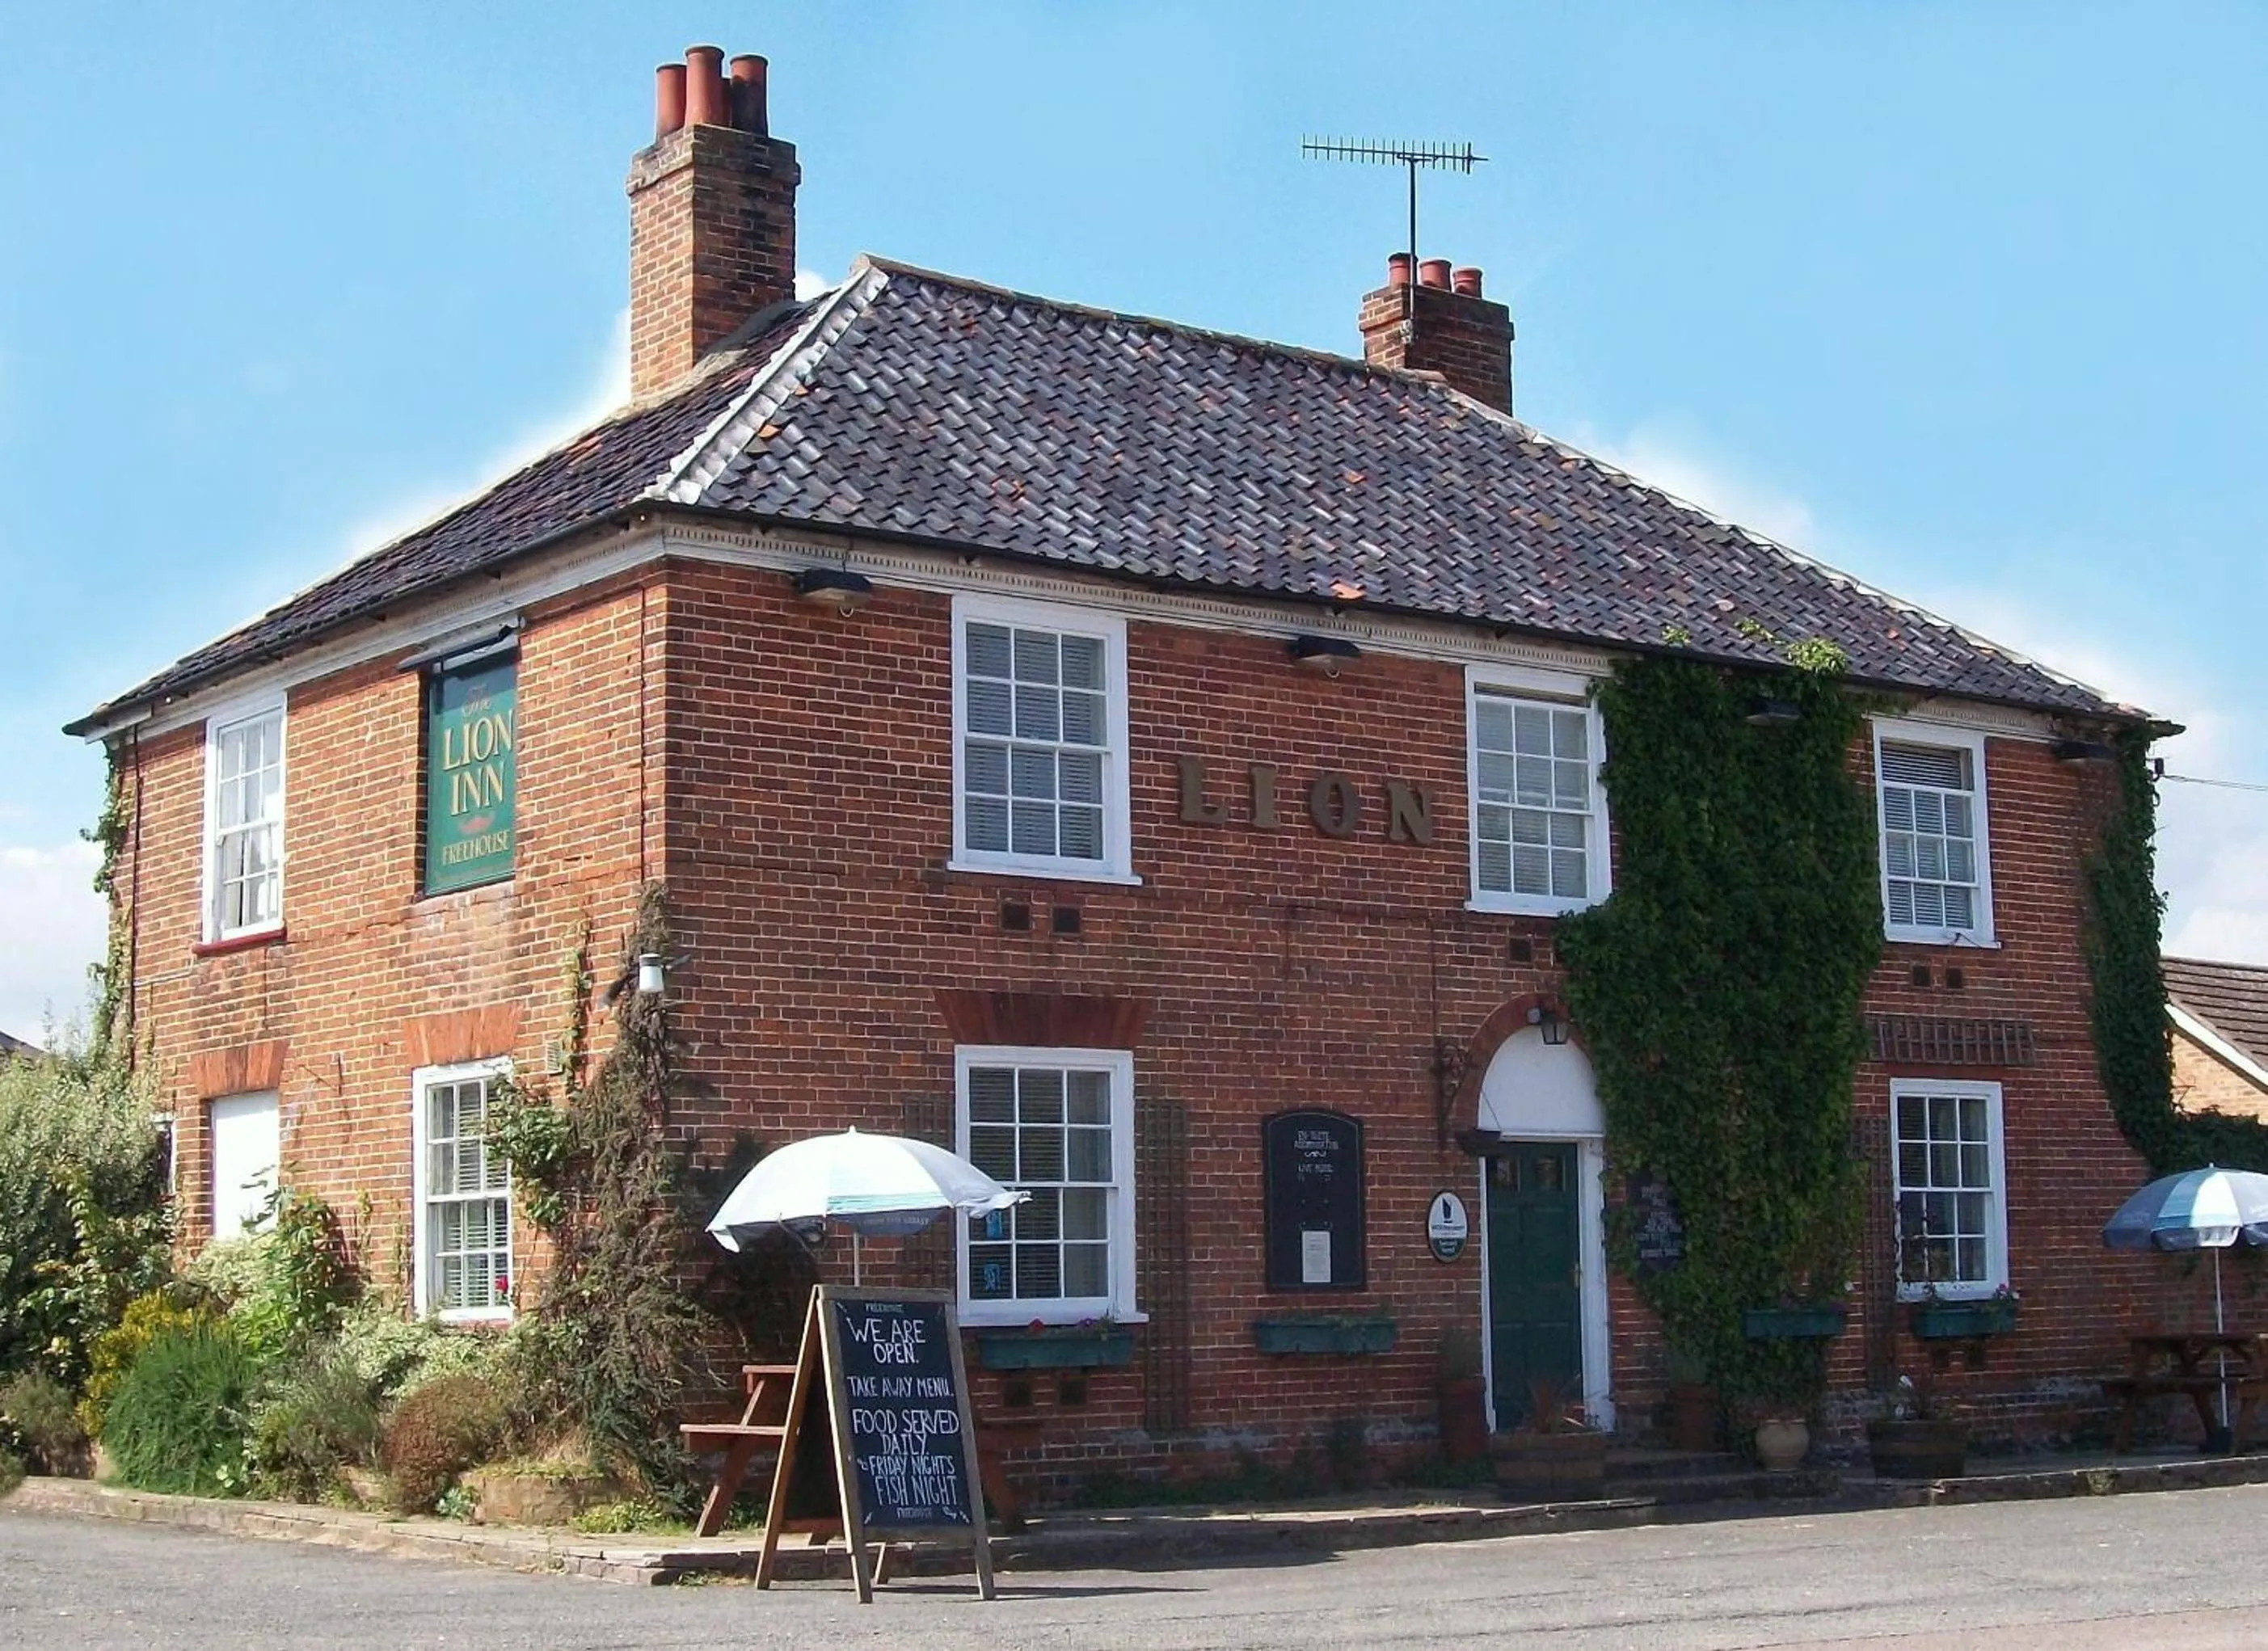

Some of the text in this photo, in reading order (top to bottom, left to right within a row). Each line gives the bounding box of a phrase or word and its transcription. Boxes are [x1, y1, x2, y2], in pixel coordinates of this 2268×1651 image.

[442, 709, 514, 771] LION
[450, 760, 505, 816] INN
[1177, 754, 1435, 844] LION
[442, 829, 510, 866] FREEHOUSE
[846, 1317, 926, 1344] WE ARE
[847, 1375, 878, 1397] TAKE
[882, 1377, 913, 1398] AWAY
[852, 1409, 960, 1434] FOOD SERVED
[869, 1455, 955, 1476] FRIDAY NIGHTS
[875, 1476, 957, 1506] FISH NIGHT
